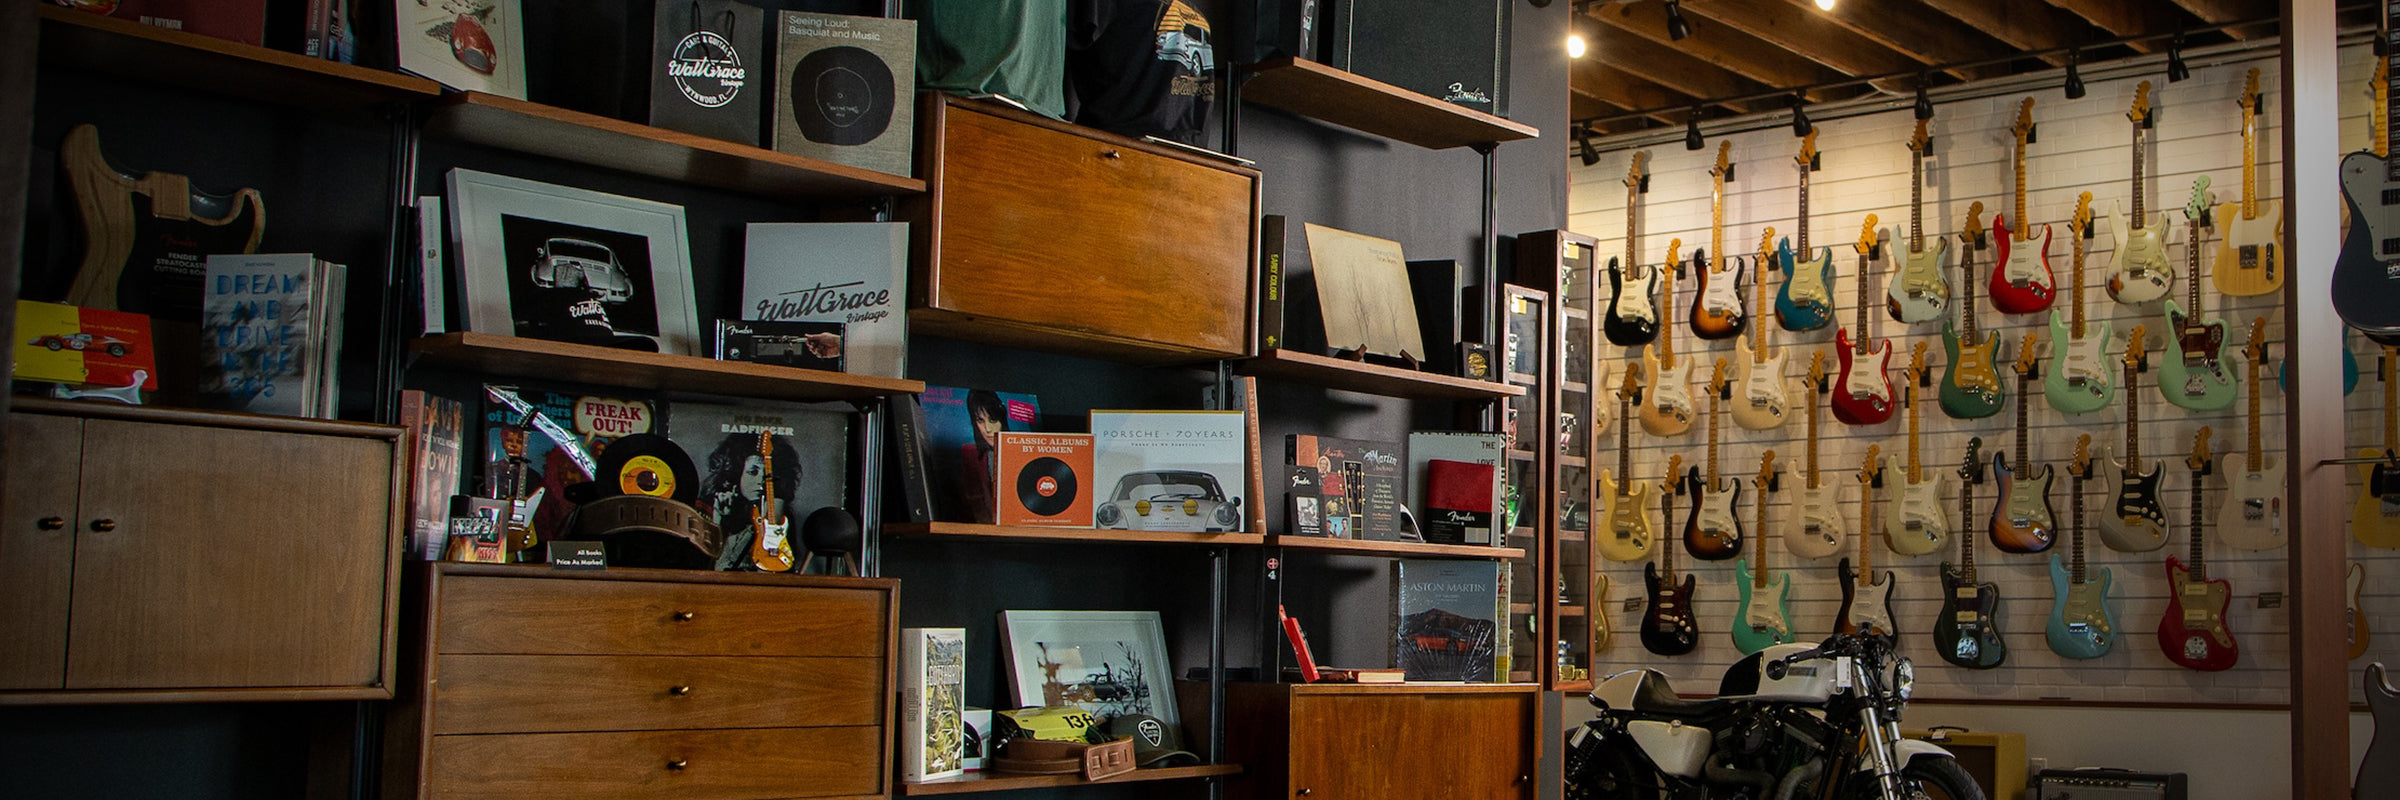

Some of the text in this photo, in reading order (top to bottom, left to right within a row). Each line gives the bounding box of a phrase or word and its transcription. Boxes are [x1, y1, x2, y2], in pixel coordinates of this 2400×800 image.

[789, 15, 850, 28] Seeing Loud:
[789, 25, 880, 41] Basquiat and Music
[168, 252, 198, 261] FENDER
[1269, 253, 1279, 273] EARLY
[153, 265, 189, 275] CUTTING
[216, 274, 300, 295] DREAM
[1268, 274, 1278, 301] COLOUR
[231, 300, 281, 320] AND
[845, 309, 889, 324] Vintage
[218, 325, 294, 347] DRIVE
[726, 325, 753, 335] Fender
[545, 392, 571, 406] The
[488, 411, 504, 424] of
[586, 402, 643, 420] FREAK
[593, 418, 632, 433] OUT!
[720, 423, 794, 436] BADFINGER
[1103, 430, 1160, 438] PORSCHE
[1006, 437, 1089, 447] CLASSIC ALBUMS
[1481, 441, 1496, 449] THE
[1363, 450, 1398, 466] Martin
[1292, 475, 1311, 488] Fender
[1447, 510, 1476, 523] Fender
[556, 558, 571, 566] Price
[1267, 570, 1277, 580] 4
[1410, 582, 1486, 593] ASTON MARTIN
